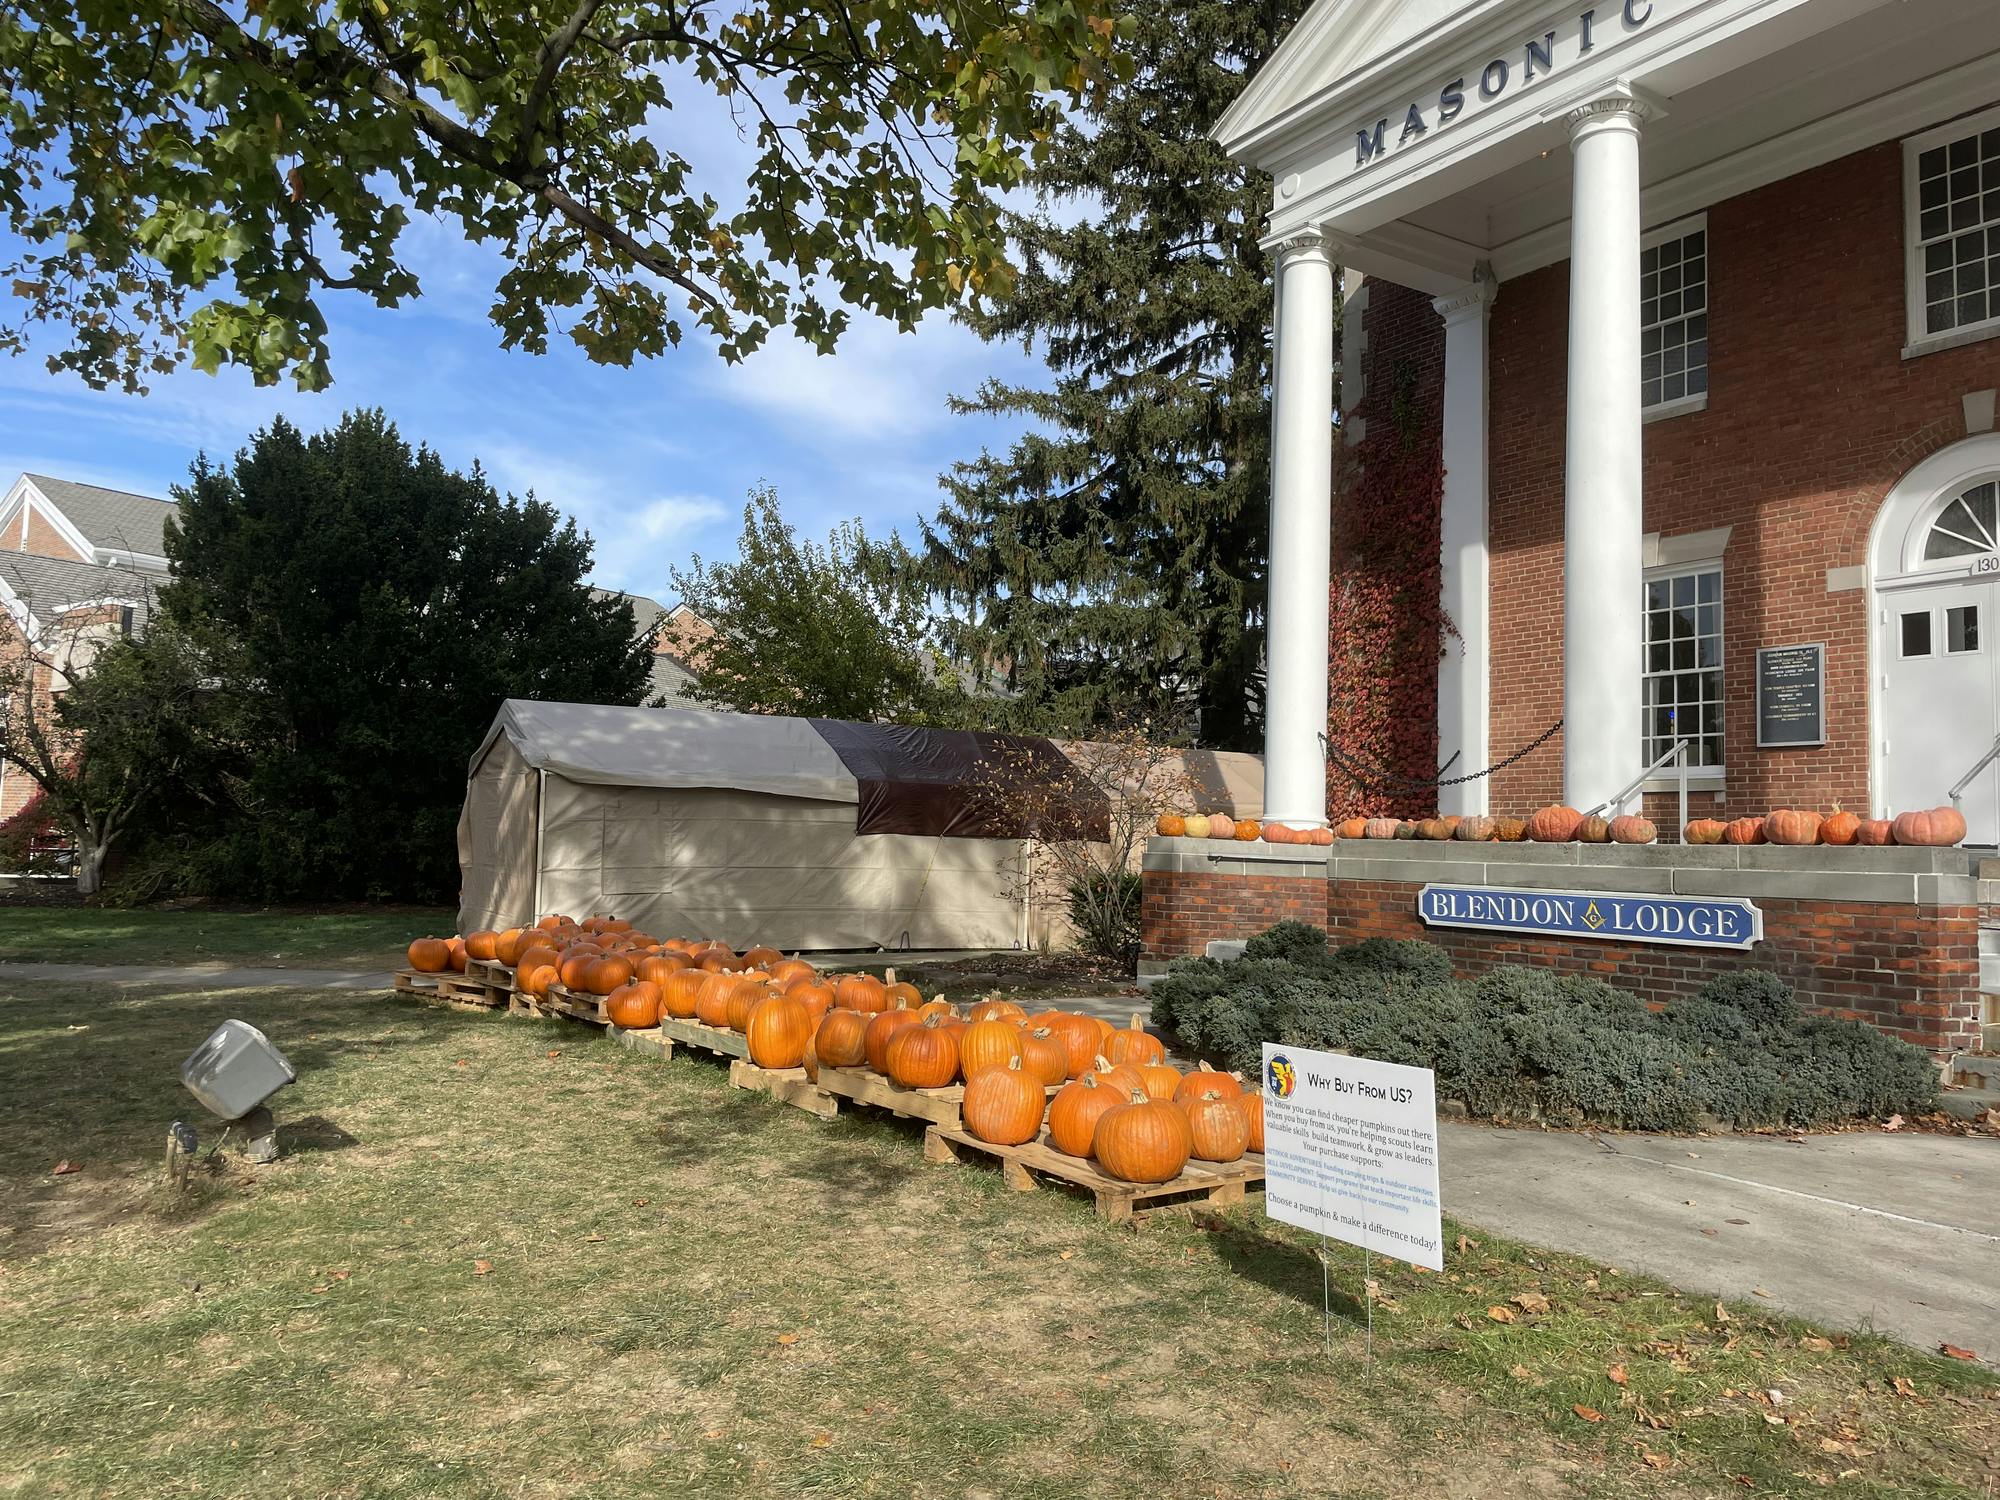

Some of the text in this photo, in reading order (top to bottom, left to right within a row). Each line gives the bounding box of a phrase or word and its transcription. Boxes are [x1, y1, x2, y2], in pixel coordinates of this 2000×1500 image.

[1355, 0, 1653, 163] MASONIC
[1978, 557, 1999, 572] 130
[1431, 893, 1740, 938] BLENDON LODGE
[1390, 1086, 1413, 1104] US?
[1265, 1097, 1273, 1107] We
[1274, 1100, 1291, 1110] know
[1292, 1104, 1304, 1114] you
[1305, 1108, 1316, 1116] can
[1318, 1108, 1330, 1120] find
[1332, 1112, 1358, 1126] cheaper
[1360, 1119, 1396, 1134] pumpkins
[1397, 1127, 1410, 1136] out
[1266, 1109, 1283, 1120] When
[1284, 1114, 1295, 1123] you
[1296, 1116, 1308, 1126] buy
[1310, 1118, 1326, 1130] from
[1336, 1126, 1358, 1137] you're
[1360, 1128, 1387, 1144] helping
[1388, 1138, 1412, 1150] scouts
[1413, 1141, 1434, 1154] learn
[1266, 1121, 1292, 1134] valuable
[1312, 1130, 1329, 1143] build
[1367, 1144, 1374, 1154] &
[1374, 1147, 1393, 1158] grow
[1394, 1151, 1403, 1159] as
[1302, 1140, 1384, 1168] Your purchase supports:
[1268, 1192, 1438, 1252] Choose a pumpkin & make a difference today!
